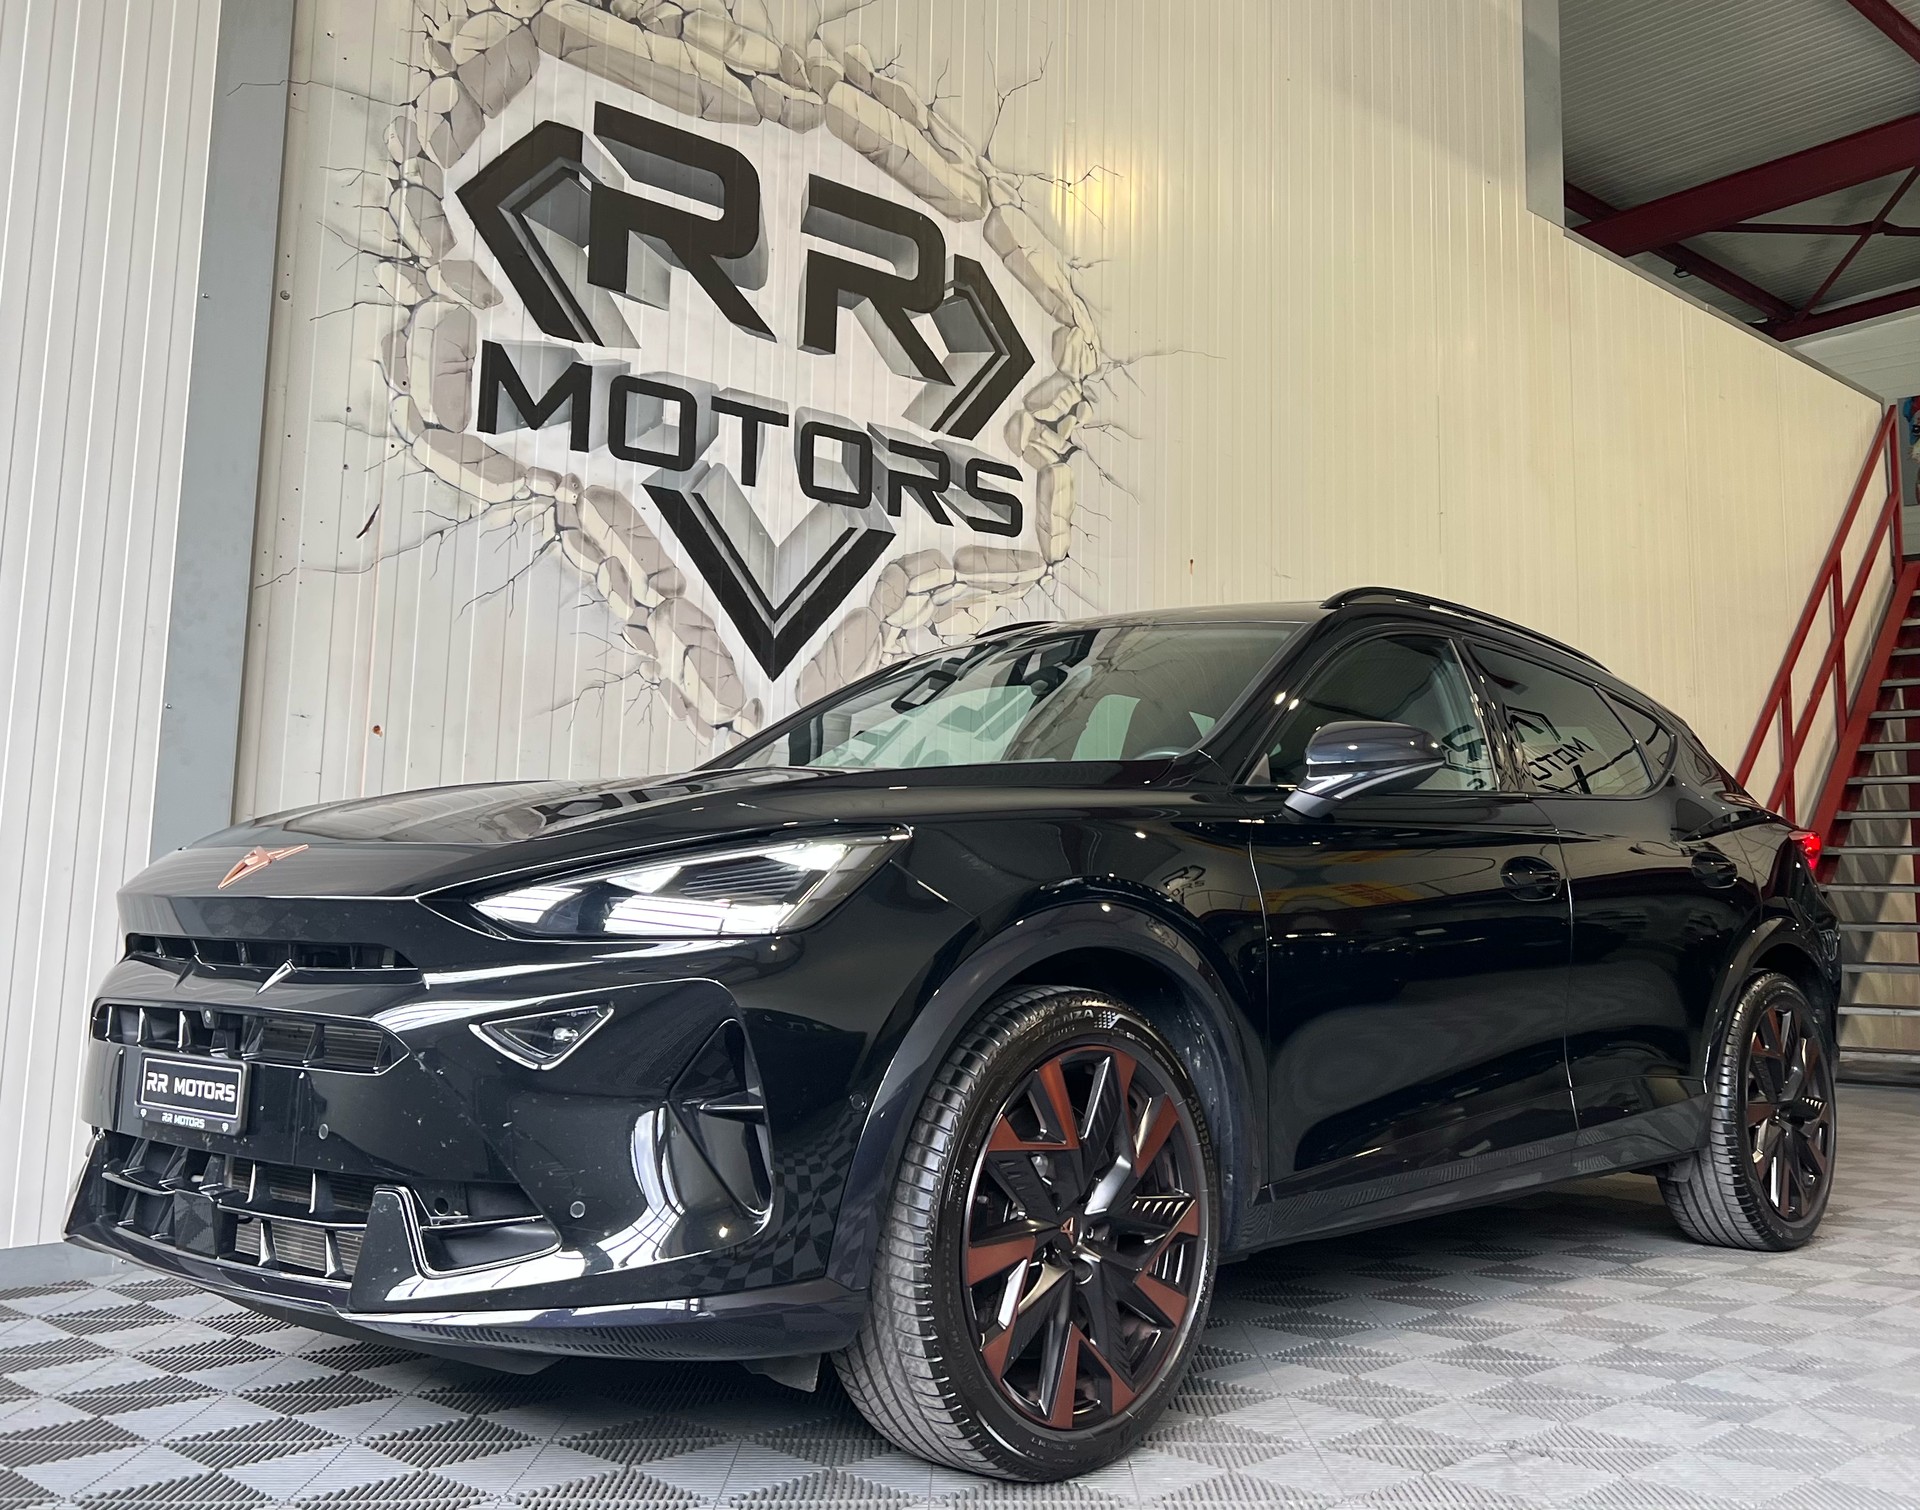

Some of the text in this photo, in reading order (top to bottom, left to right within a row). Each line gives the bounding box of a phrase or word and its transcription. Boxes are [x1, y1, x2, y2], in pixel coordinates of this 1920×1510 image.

[587, 101, 955, 386] RR
[477, 340, 1023, 538] MOTORS
[146, 1071, 236, 1103] RR MOTORS
[161, 1112, 205, 1129] RR MOTORS
